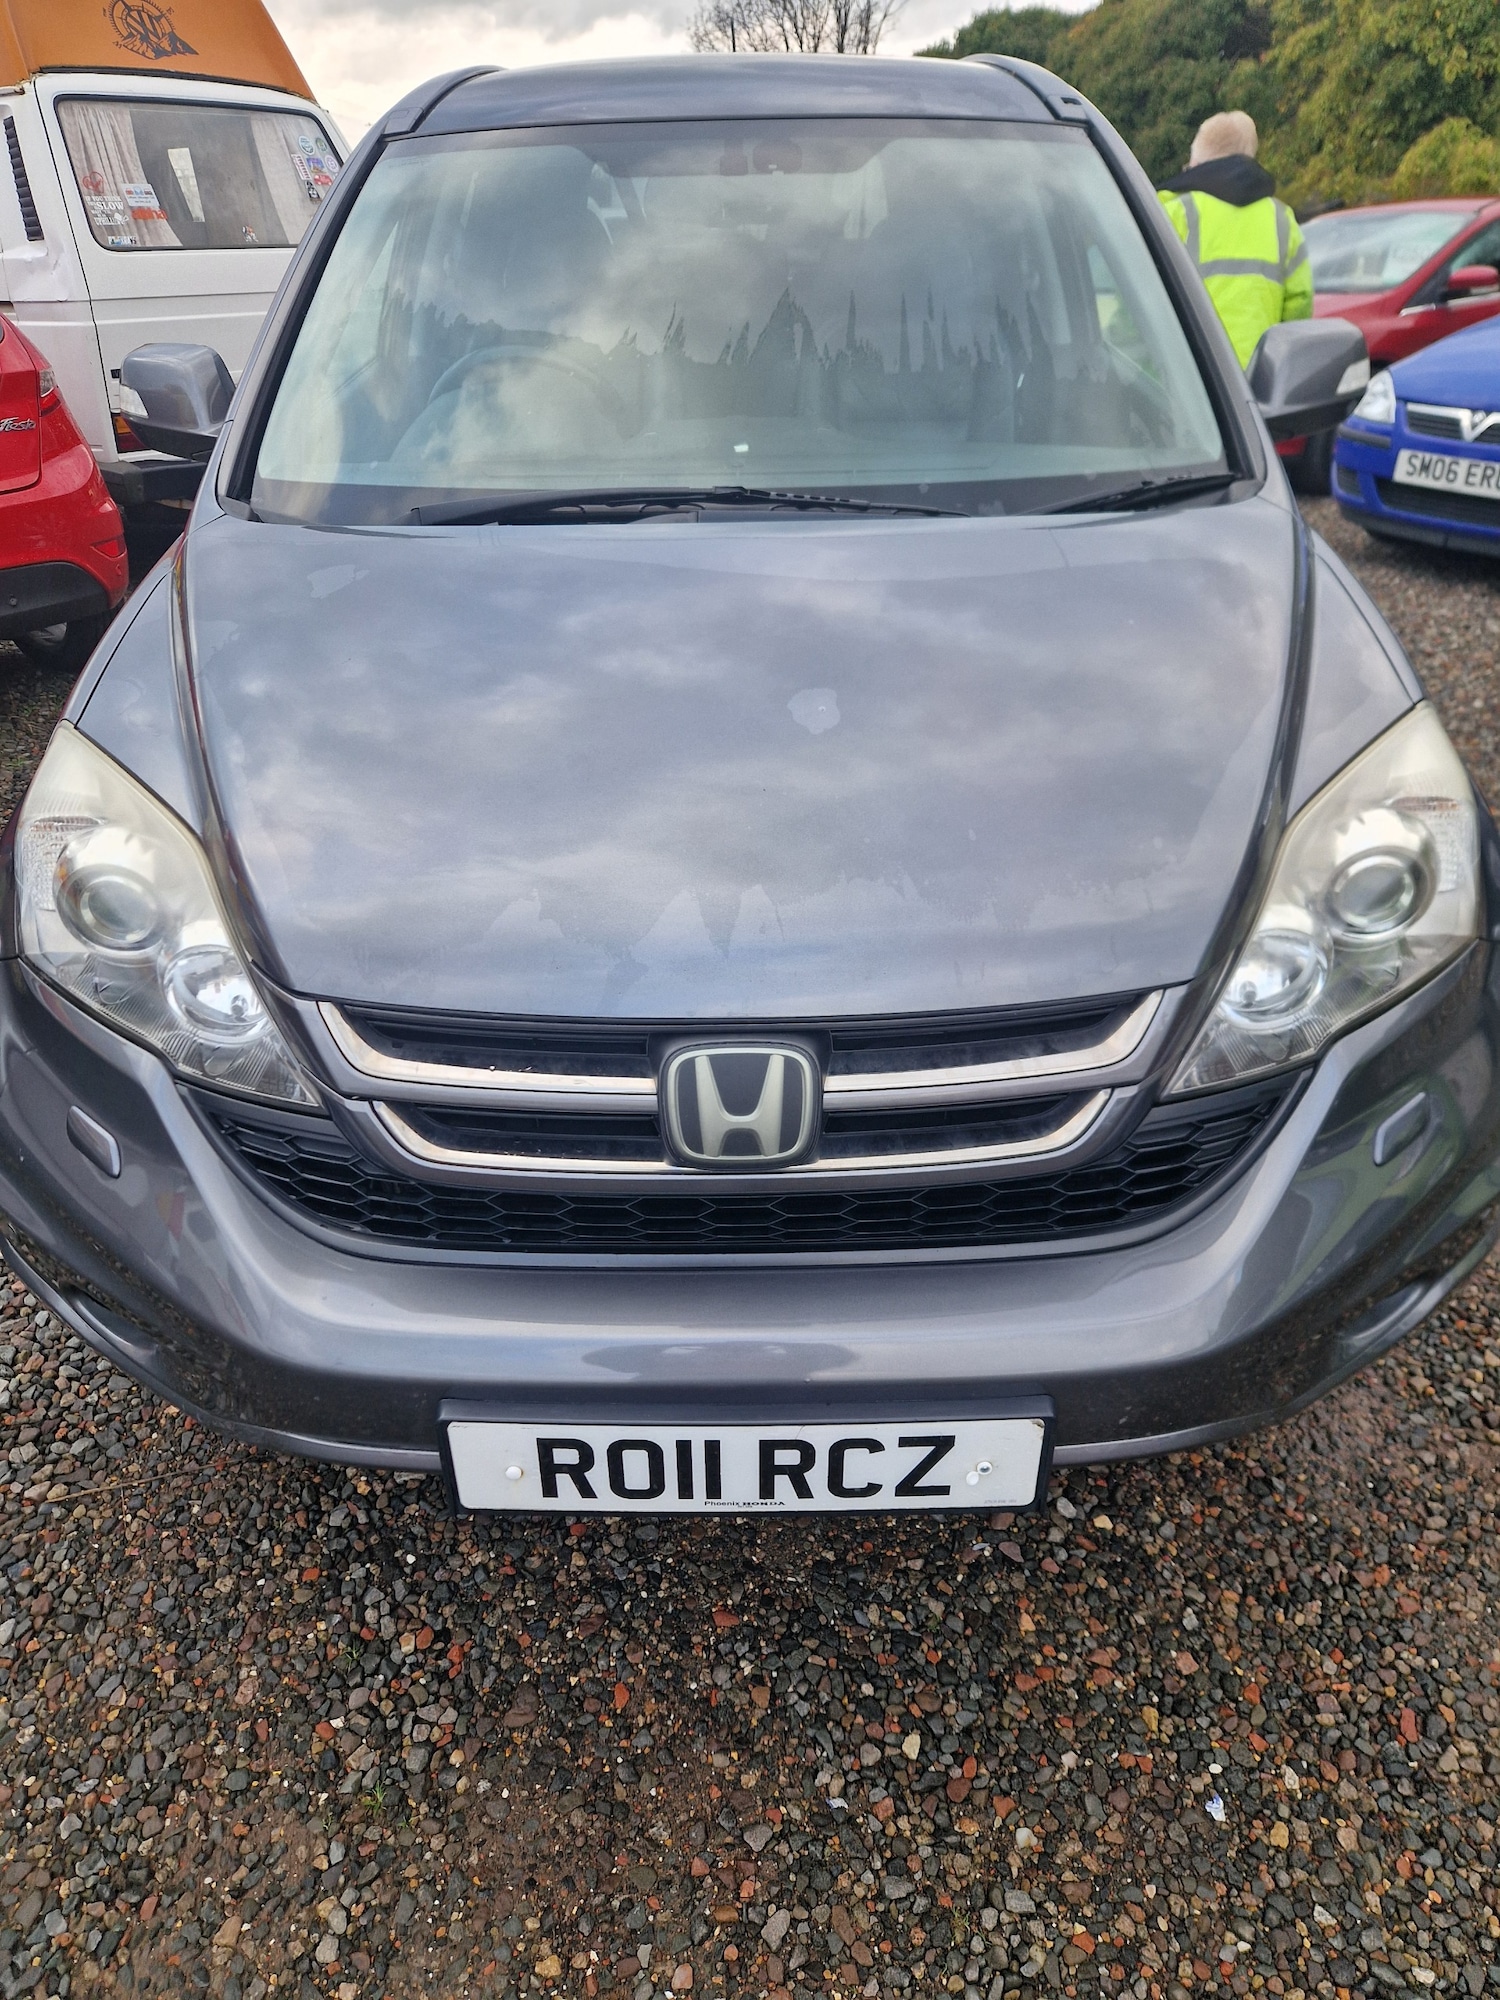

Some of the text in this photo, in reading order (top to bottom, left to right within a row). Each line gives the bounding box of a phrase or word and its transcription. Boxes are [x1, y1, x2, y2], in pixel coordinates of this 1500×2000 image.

[96, 201, 124, 210] SLOW
[0, 416, 36, 432] Fiesta
[1406, 453, 1460, 483] SM06
[758, 1435, 956, 1499] RCZ
